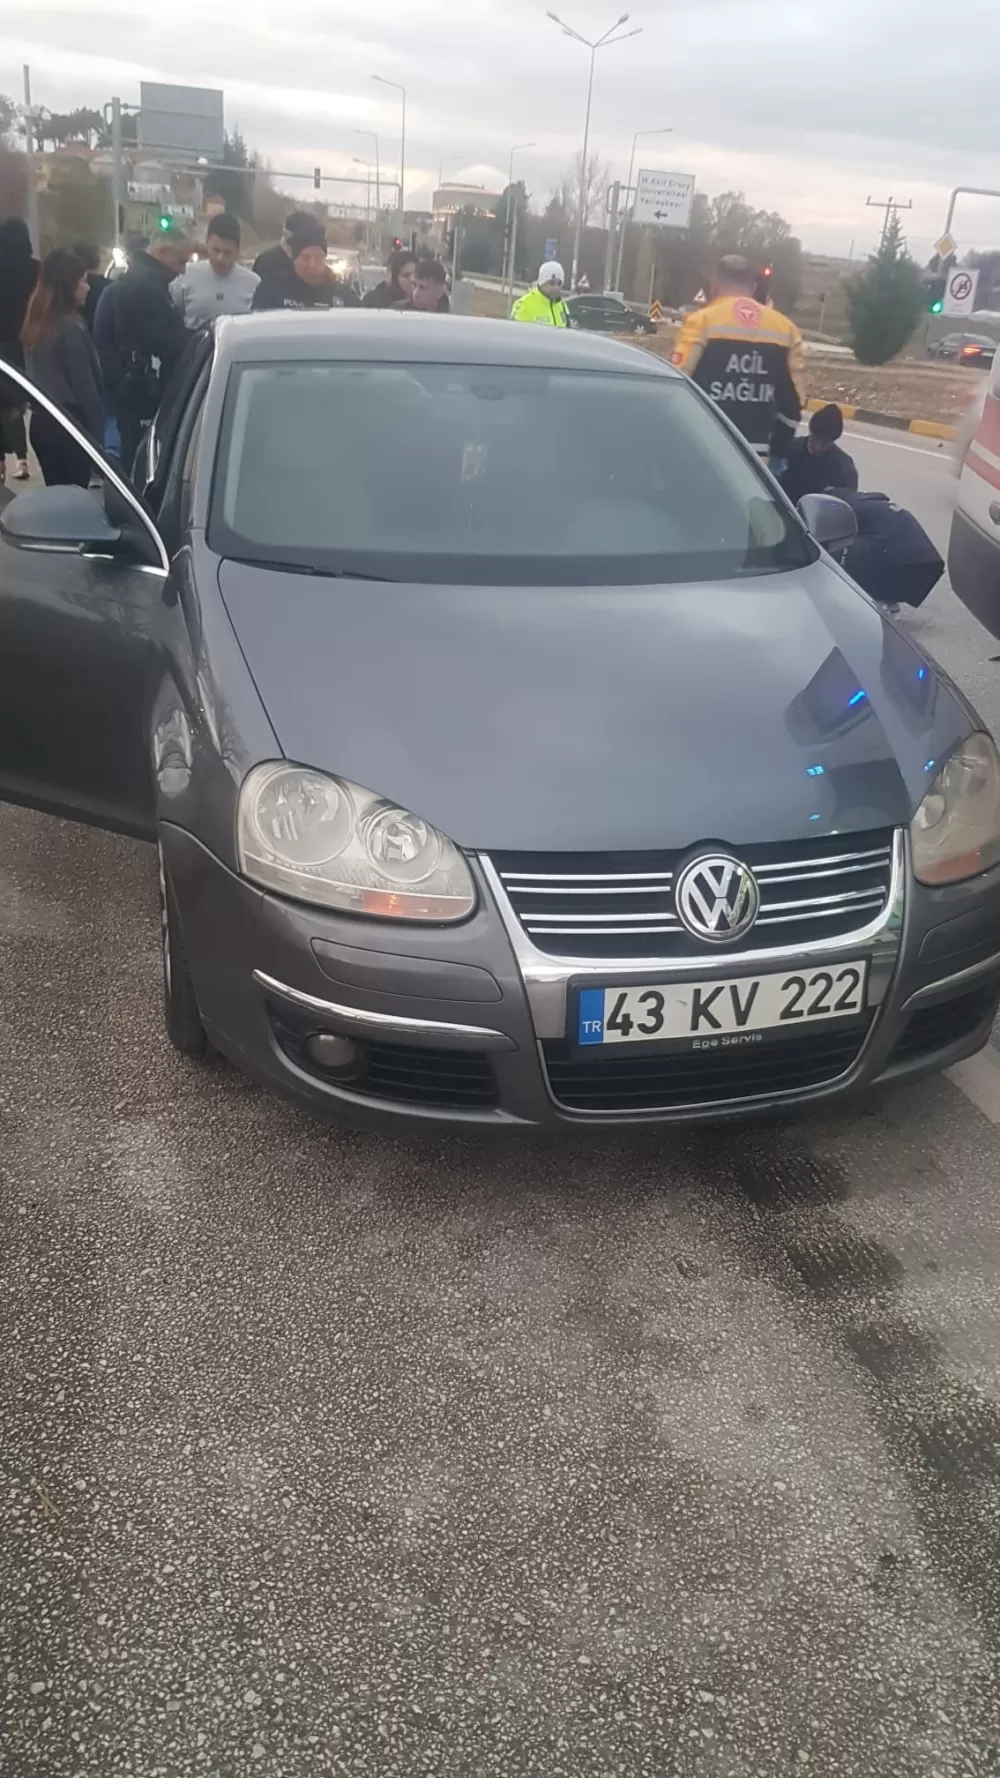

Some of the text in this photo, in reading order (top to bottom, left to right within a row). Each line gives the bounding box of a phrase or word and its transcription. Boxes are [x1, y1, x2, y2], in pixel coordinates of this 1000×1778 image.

[606, 968, 860, 1036] 43 KV 222
[582, 1020, 601, 1033] TR
[692, 1032, 762, 1049] Ege Servis
